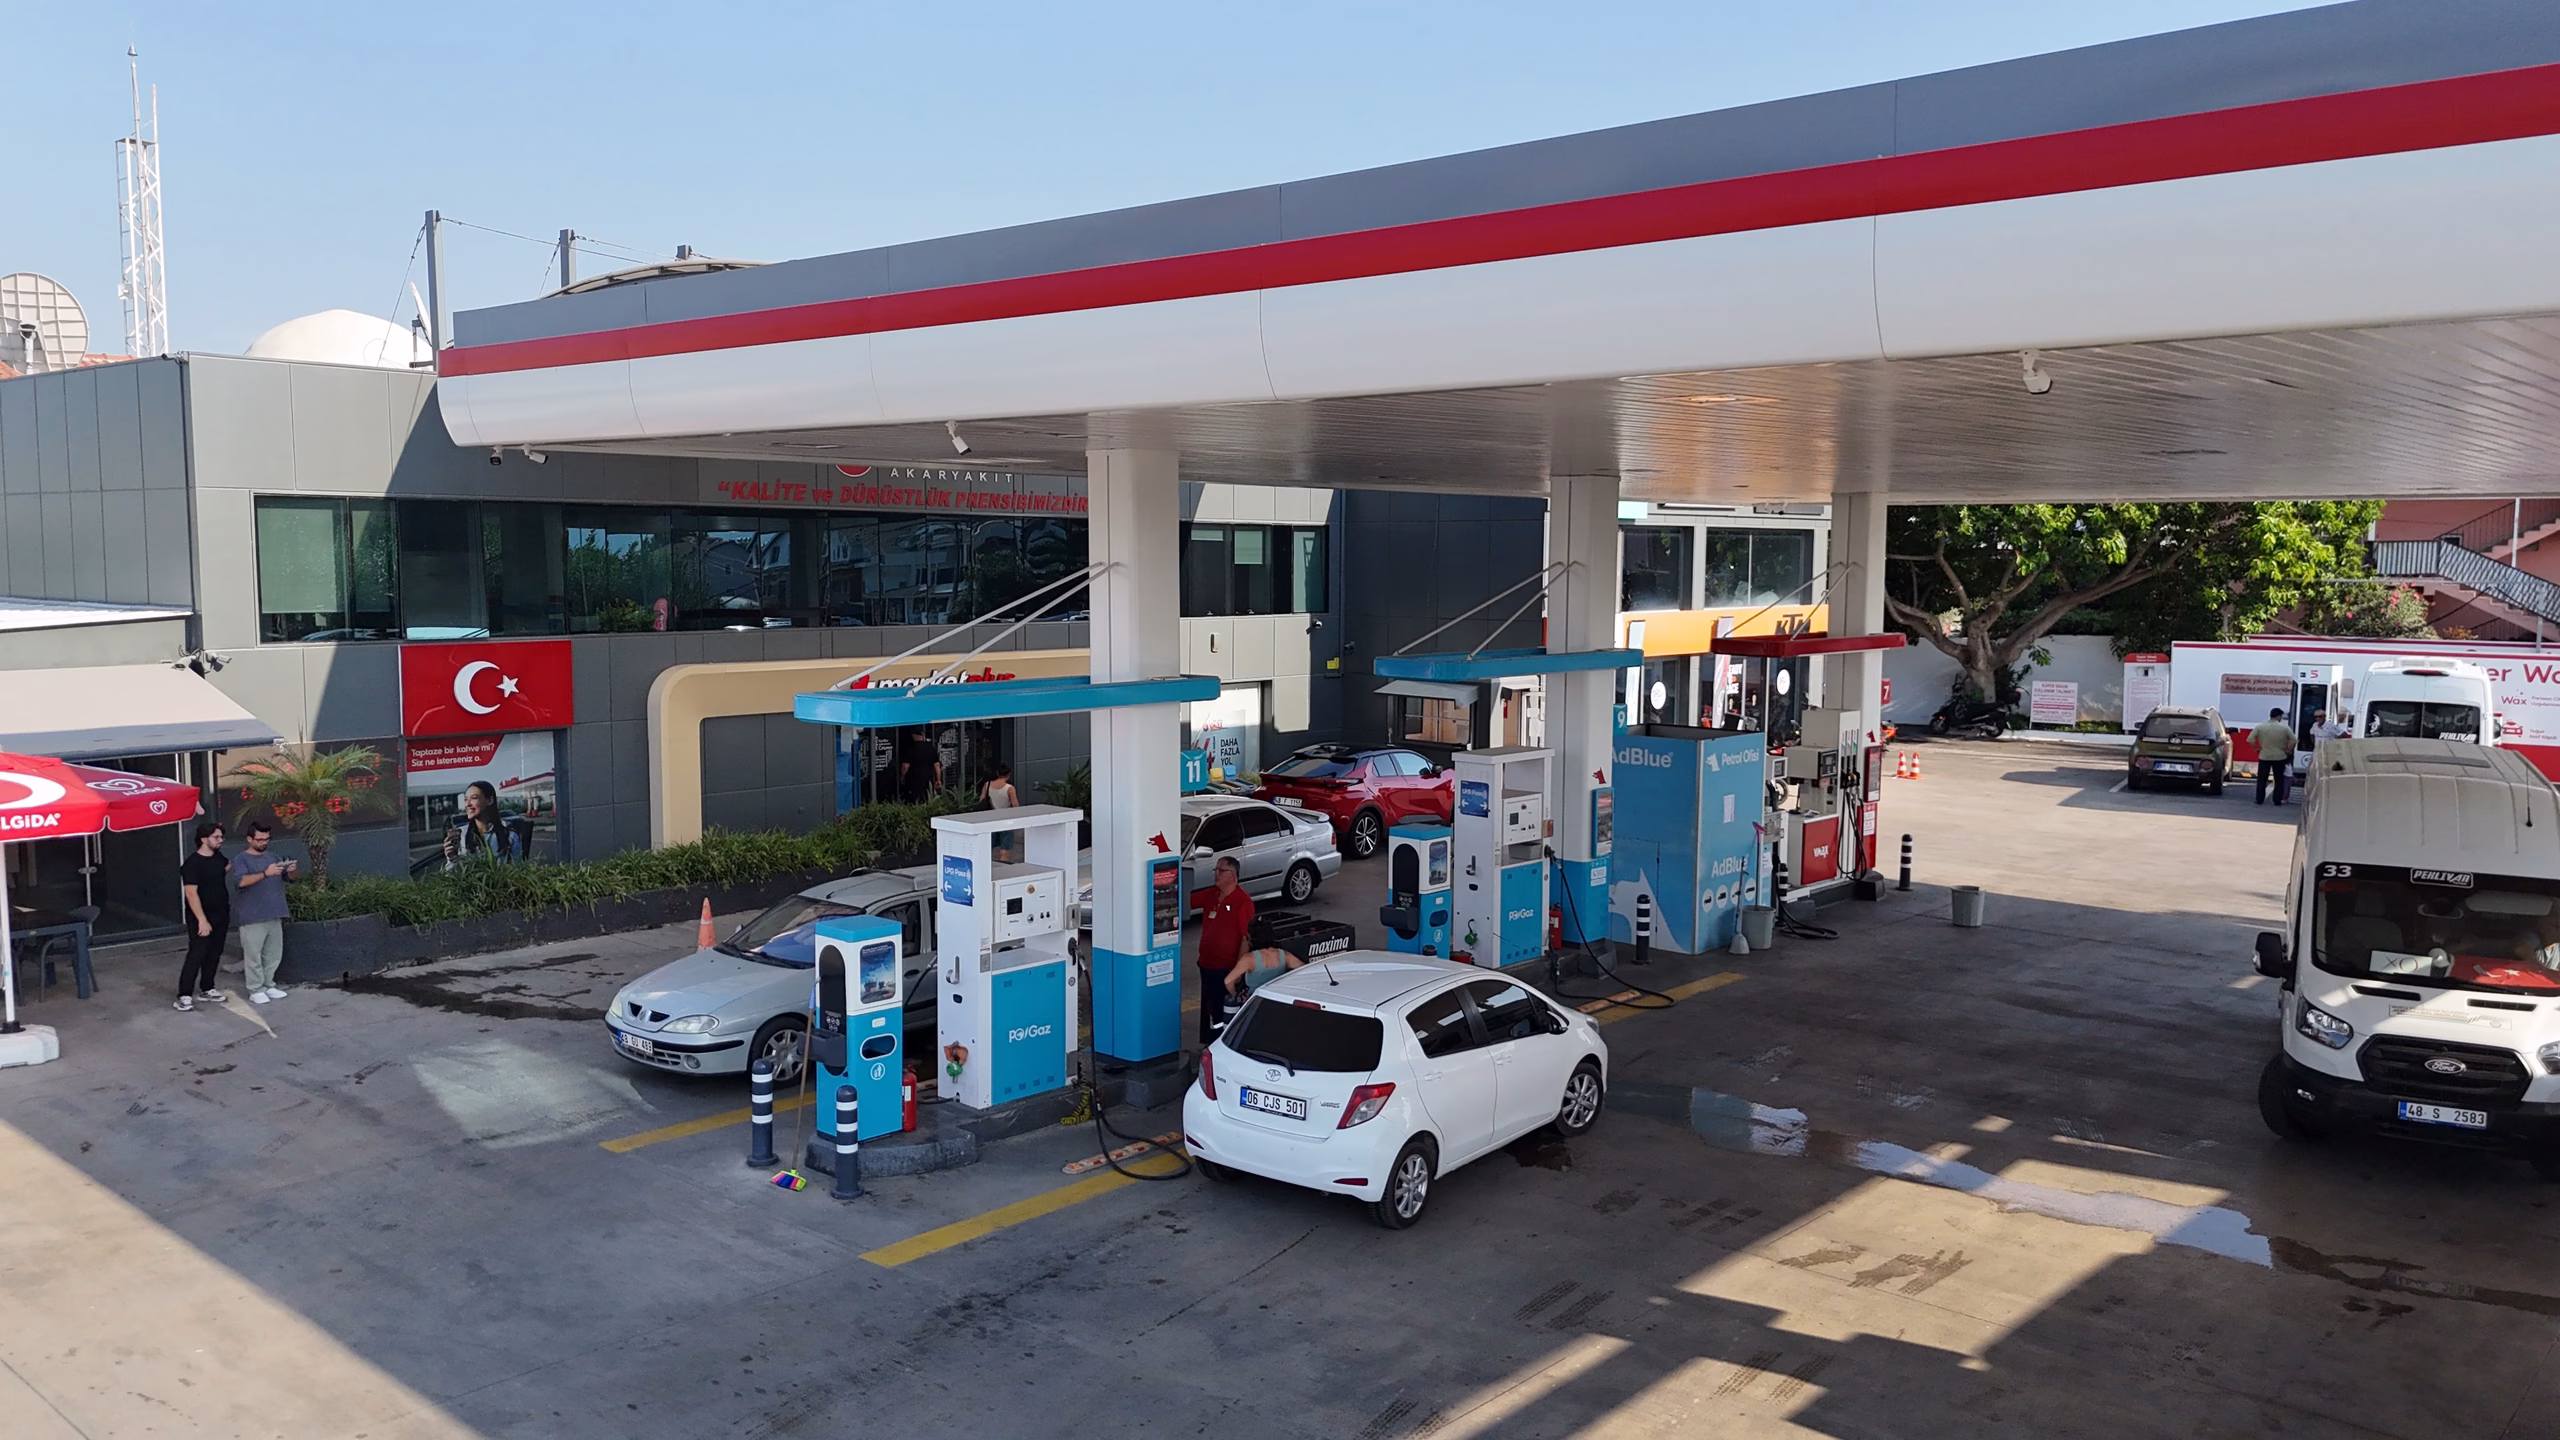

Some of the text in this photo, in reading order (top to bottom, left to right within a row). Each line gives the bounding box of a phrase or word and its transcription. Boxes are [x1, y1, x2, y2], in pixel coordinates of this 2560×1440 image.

[890, 467, 1013, 484] AKARYAKIT
[812, 488, 833, 504] ve
[2310, 670, 2319, 679] 5
[1883, 685, 1890, 700] 7
[2501, 695, 2527, 705] Wax
[1617, 711, 1626, 728] 9
[411, 749, 443, 758] Taptaze
[456, 745, 480, 753] kahve
[481, 742, 495, 751] mi?
[1220, 738, 1239, 748] DAHA
[1220, 747, 1241, 756] FAZLA
[411, 759, 424, 767] Siz
[436, 755, 473, 765] isterseniz
[1221, 757, 1233, 766] YOL
[1721, 752, 1742, 766] Petrol
[1186, 761, 1201, 783] 11
[2323, 865, 2352, 878] 33
[1308, 935, 1350, 957] maxima
[2431, 1060, 2456, 1072] Ford
[1247, 1091, 1259, 1105] 06
[1263, 1095, 1281, 1110] CJS
[1286, 1101, 1303, 1116] 501
[2408, 1104, 2485, 1125] 48 S 2583
